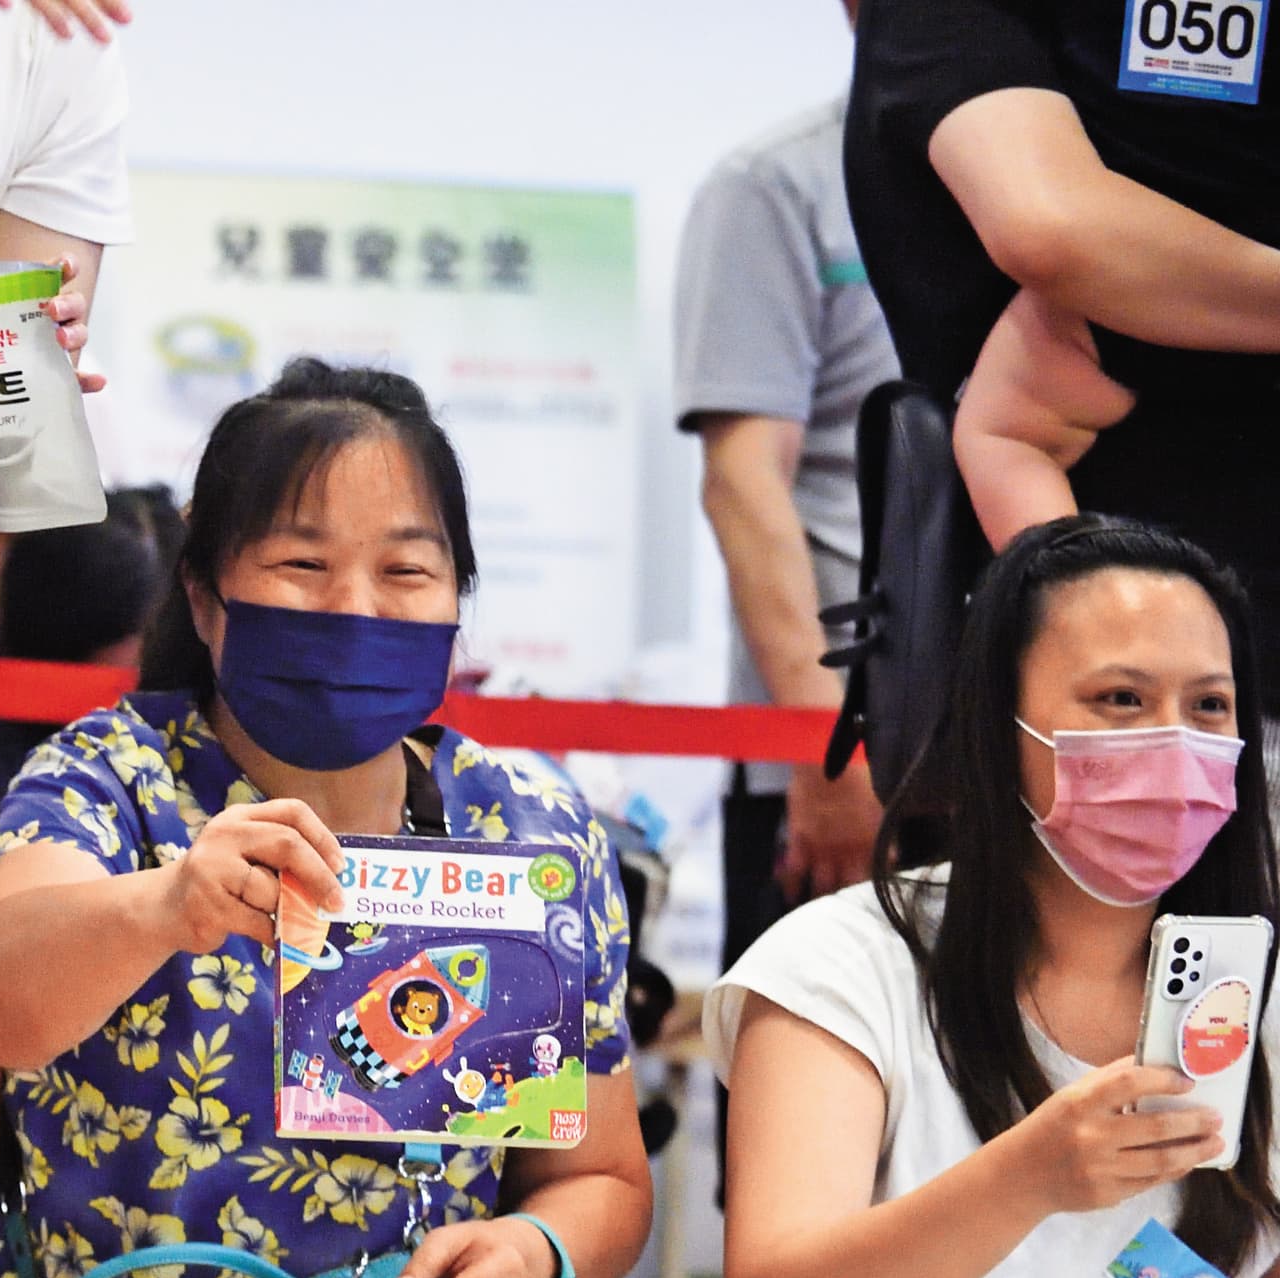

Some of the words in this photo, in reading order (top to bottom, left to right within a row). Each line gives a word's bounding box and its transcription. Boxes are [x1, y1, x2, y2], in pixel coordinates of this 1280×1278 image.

[1139, 0, 1255, 59] 050
[338, 857, 431, 898] Bizzy
[441, 861, 524, 897] Bear
[356, 898, 424, 917] Space
[431, 901, 506, 919] Rocket
[294, 1111, 326, 1123] Benji
[328, 1112, 371, 1124] Davies
